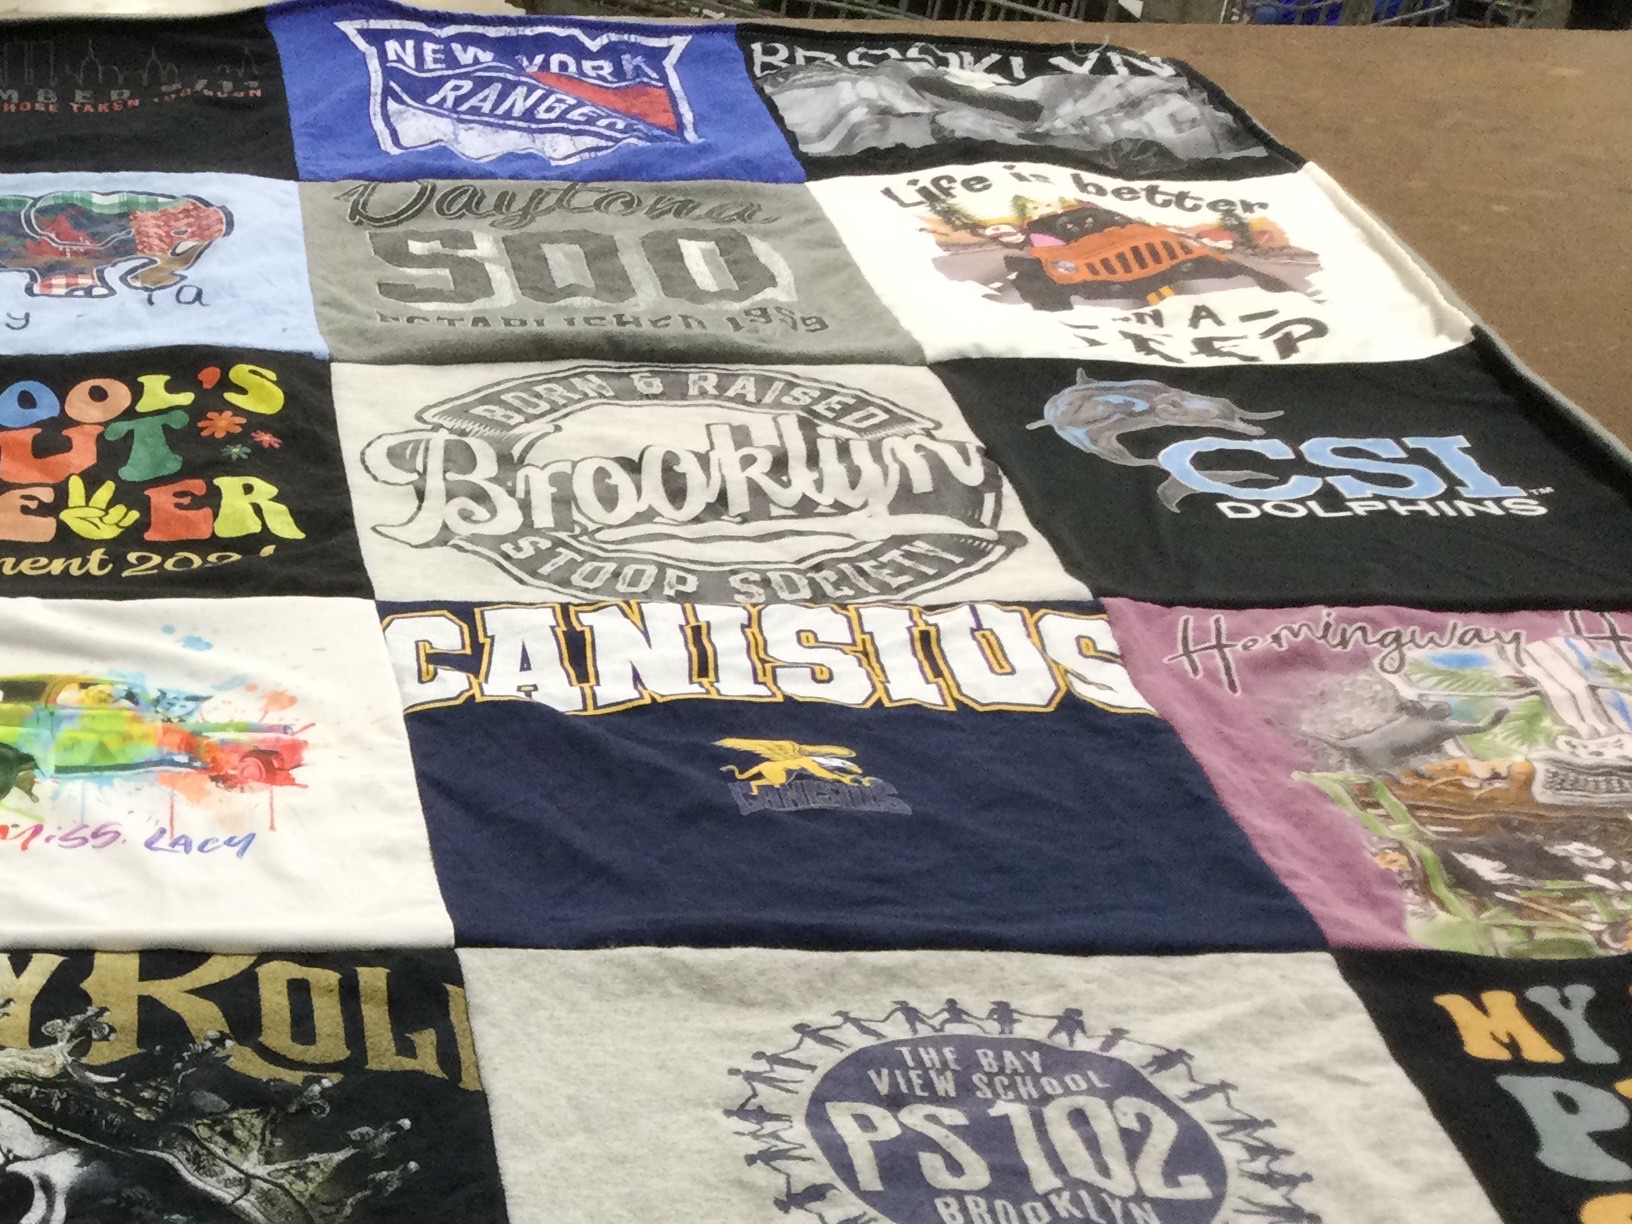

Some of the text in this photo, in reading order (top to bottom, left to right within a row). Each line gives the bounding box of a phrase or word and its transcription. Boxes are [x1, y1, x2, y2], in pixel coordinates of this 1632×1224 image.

[384, 38, 661, 82] NEW YORK
[425, 78, 668, 138] RANGER
[334, 180, 780, 231] Daytona
[879, 170, 991, 209] Life
[1069, 171, 1270, 215] better
[368, 228, 799, 313] 500
[1072, 316, 1331, 361] EEP
[479, 369, 612, 432] BORN
[688, 369, 896, 433] RAISED
[361, 413, 998, 549] Brooklyn
[1157, 435, 1528, 501] CSI
[1218, 498, 1550, 519] DOLPHINS
[120, 544, 277, 578] 202
[499, 534, 967, 602] STOOP SOCIETY
[381, 601, 1159, 716] CANISIUS
[1162, 606, 1528, 697] Hemingway
[1432, 983, 1621, 1064] MY
[868, 1067, 1111, 1100] VIEW SCHOOL
[893, 1045, 1044, 1075] THE BAY
[824, 1095, 1214, 1202] PS 102
